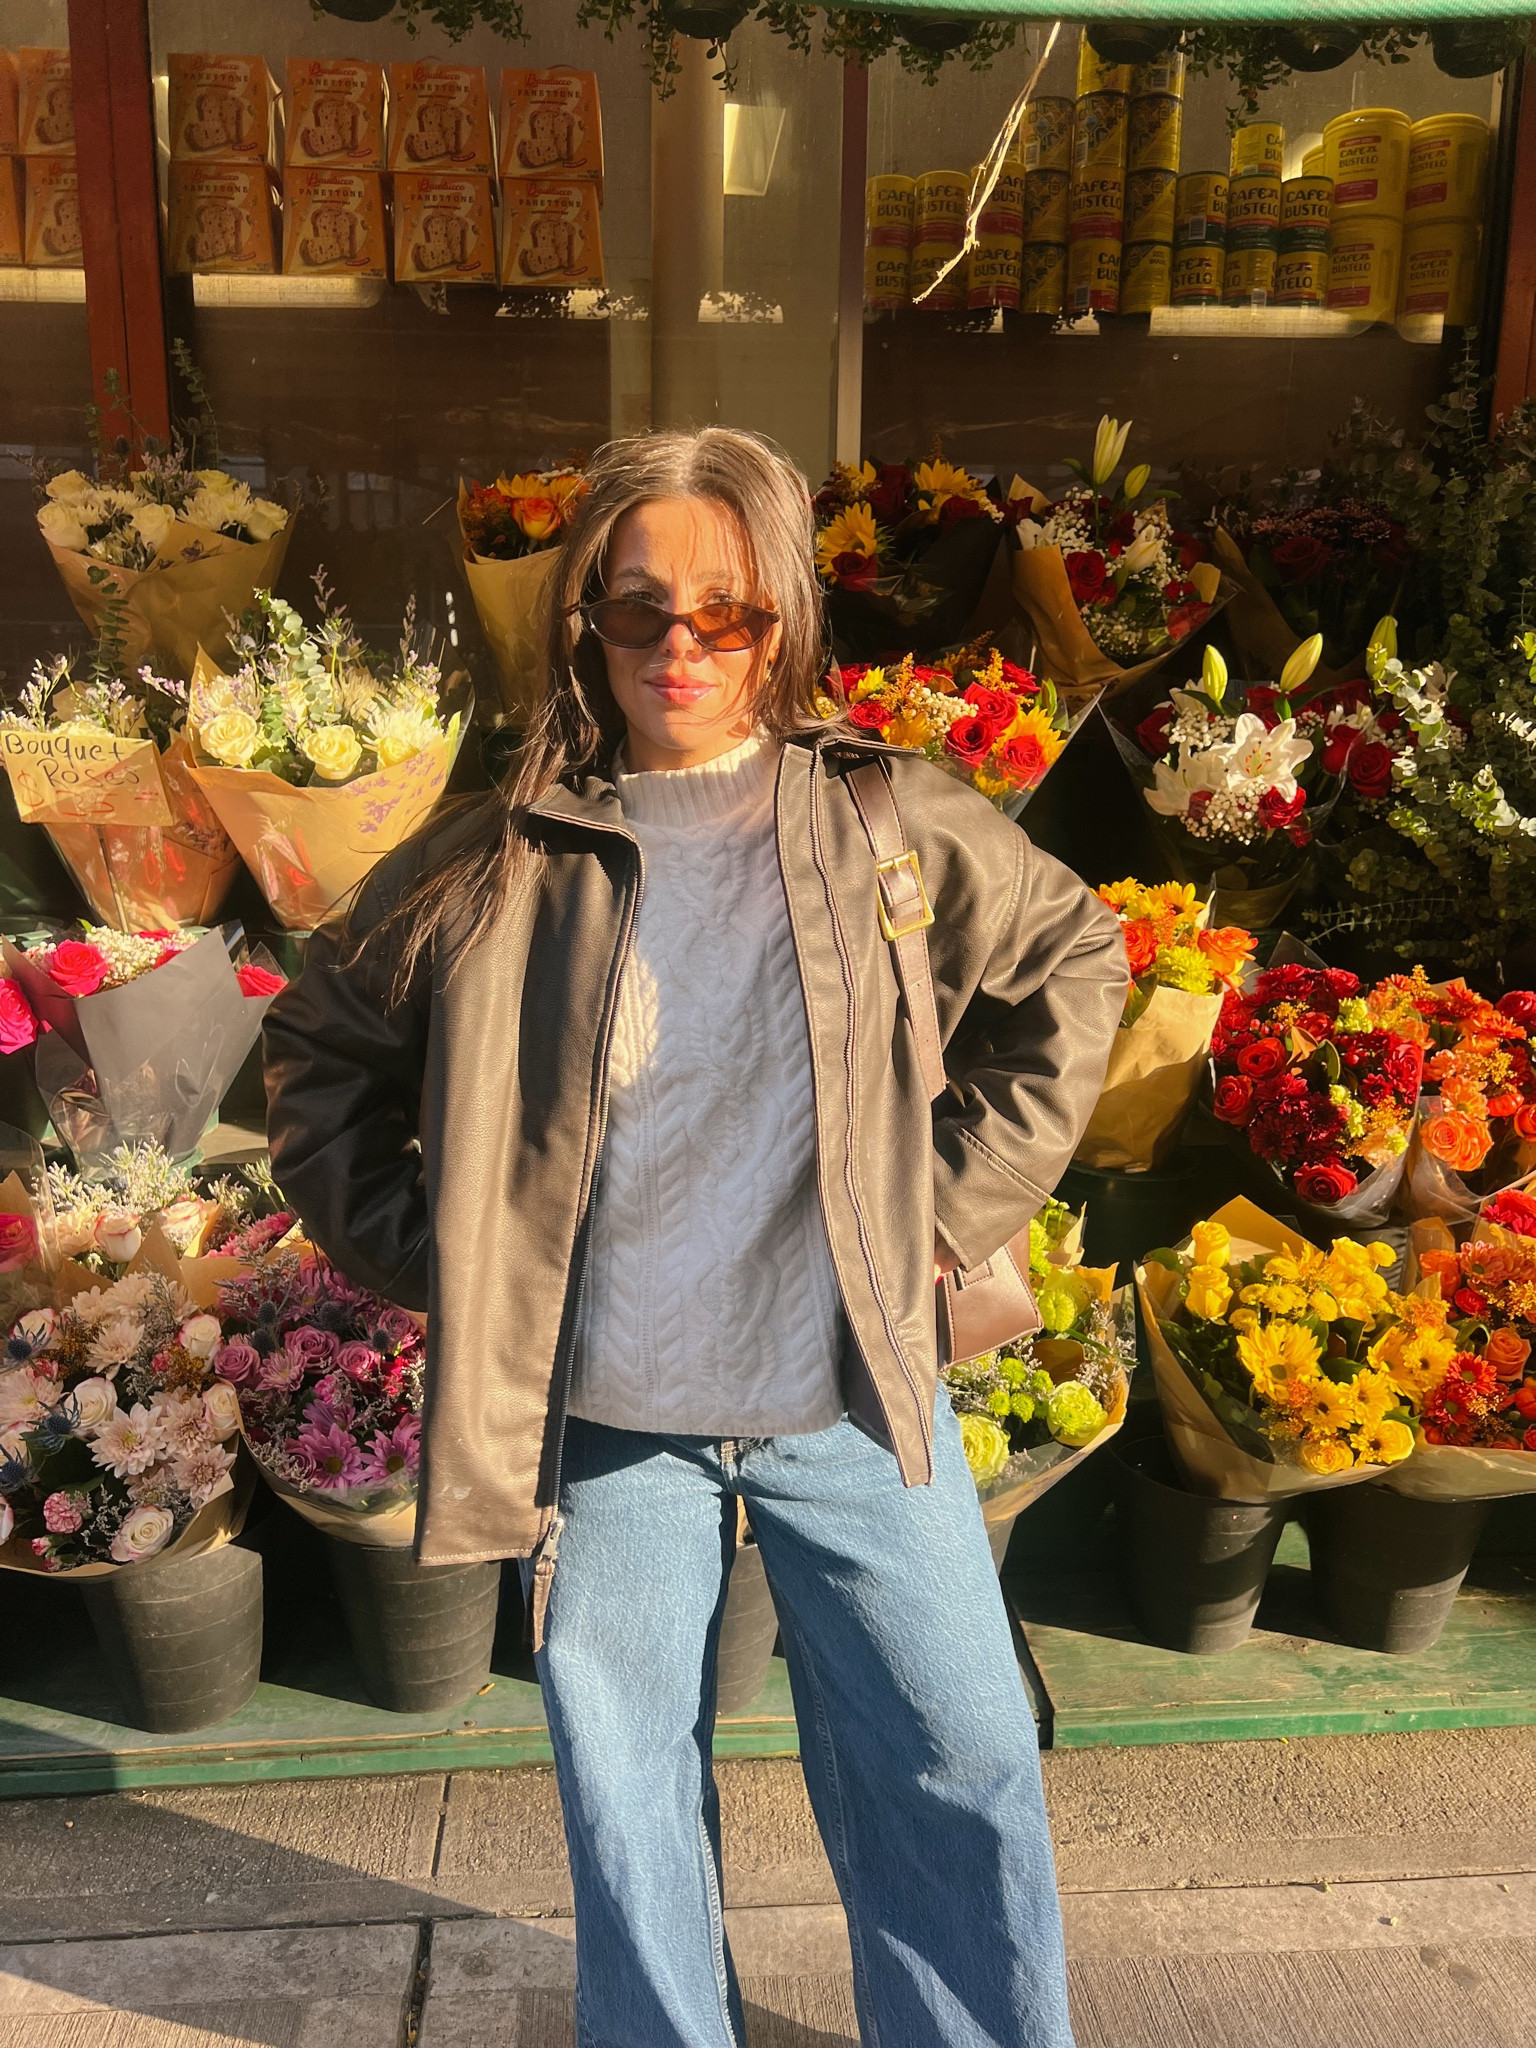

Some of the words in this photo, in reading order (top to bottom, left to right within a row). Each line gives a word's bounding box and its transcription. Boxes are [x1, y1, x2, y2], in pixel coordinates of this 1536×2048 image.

[302, 78, 366, 88] PANETTONE
[405, 83, 469, 93] PANETTONE
[518, 89, 580, 99] PANETTONE
[184, 184, 249, 194] PANETTONE
[299, 188, 364, 198] PANETTONE
[410, 194, 475, 204] PANETTONE
[1286, 189, 1326, 203] CAFE
[518, 199, 581, 208] PANETTONE
[5, 733, 124, 769] Bouquet
[37, 758, 140, 790] Roses
